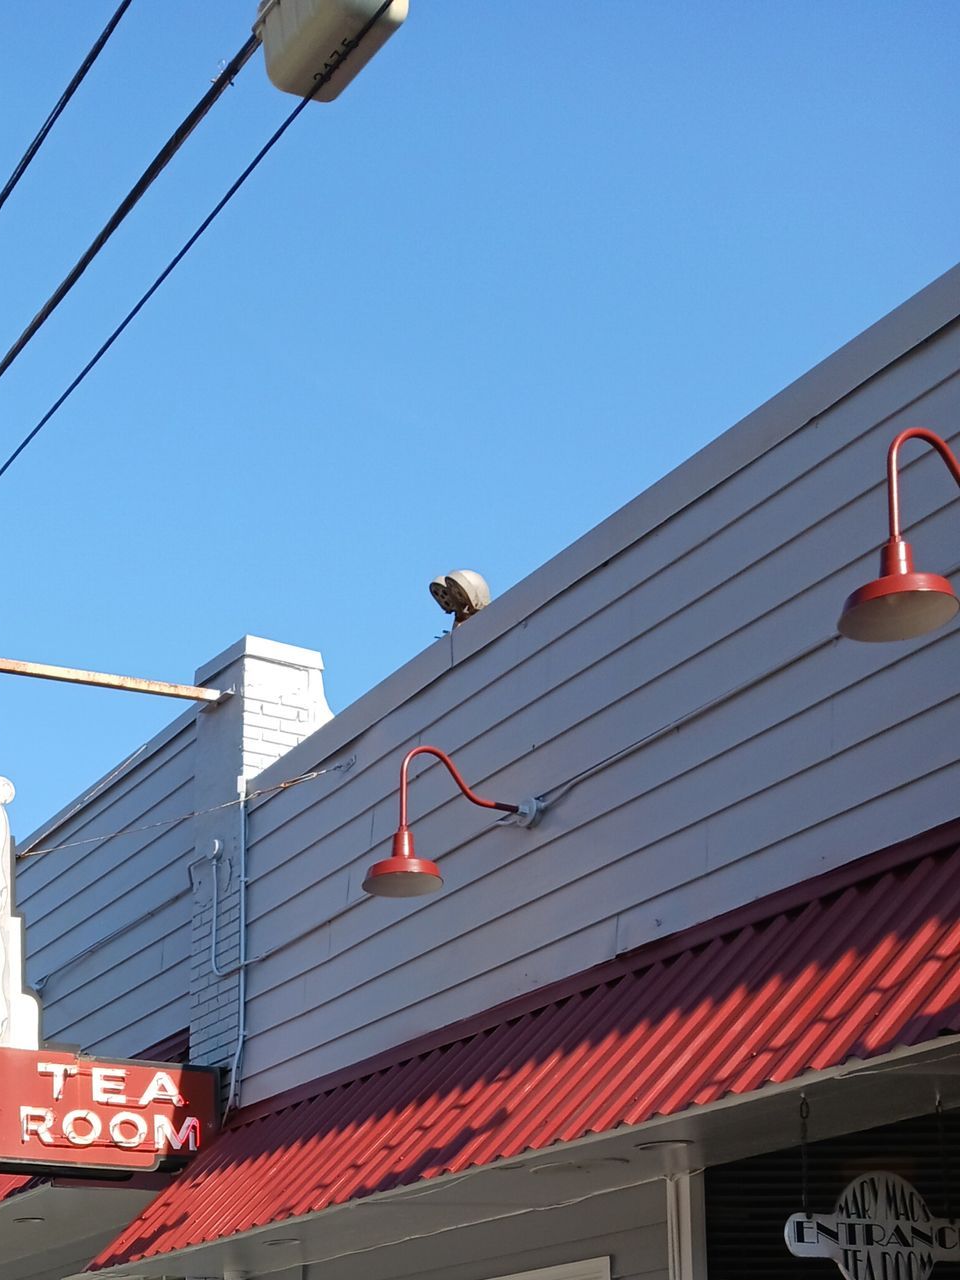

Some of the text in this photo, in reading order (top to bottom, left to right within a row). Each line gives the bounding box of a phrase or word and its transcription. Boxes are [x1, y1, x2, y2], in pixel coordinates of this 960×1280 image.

[37, 1061, 189, 1107] TEA
[19, 1106, 201, 1152] ROOM
[837, 1176, 931, 1222] MARY MAC'S
[793, 1220, 960, 1249] ENTRANC
